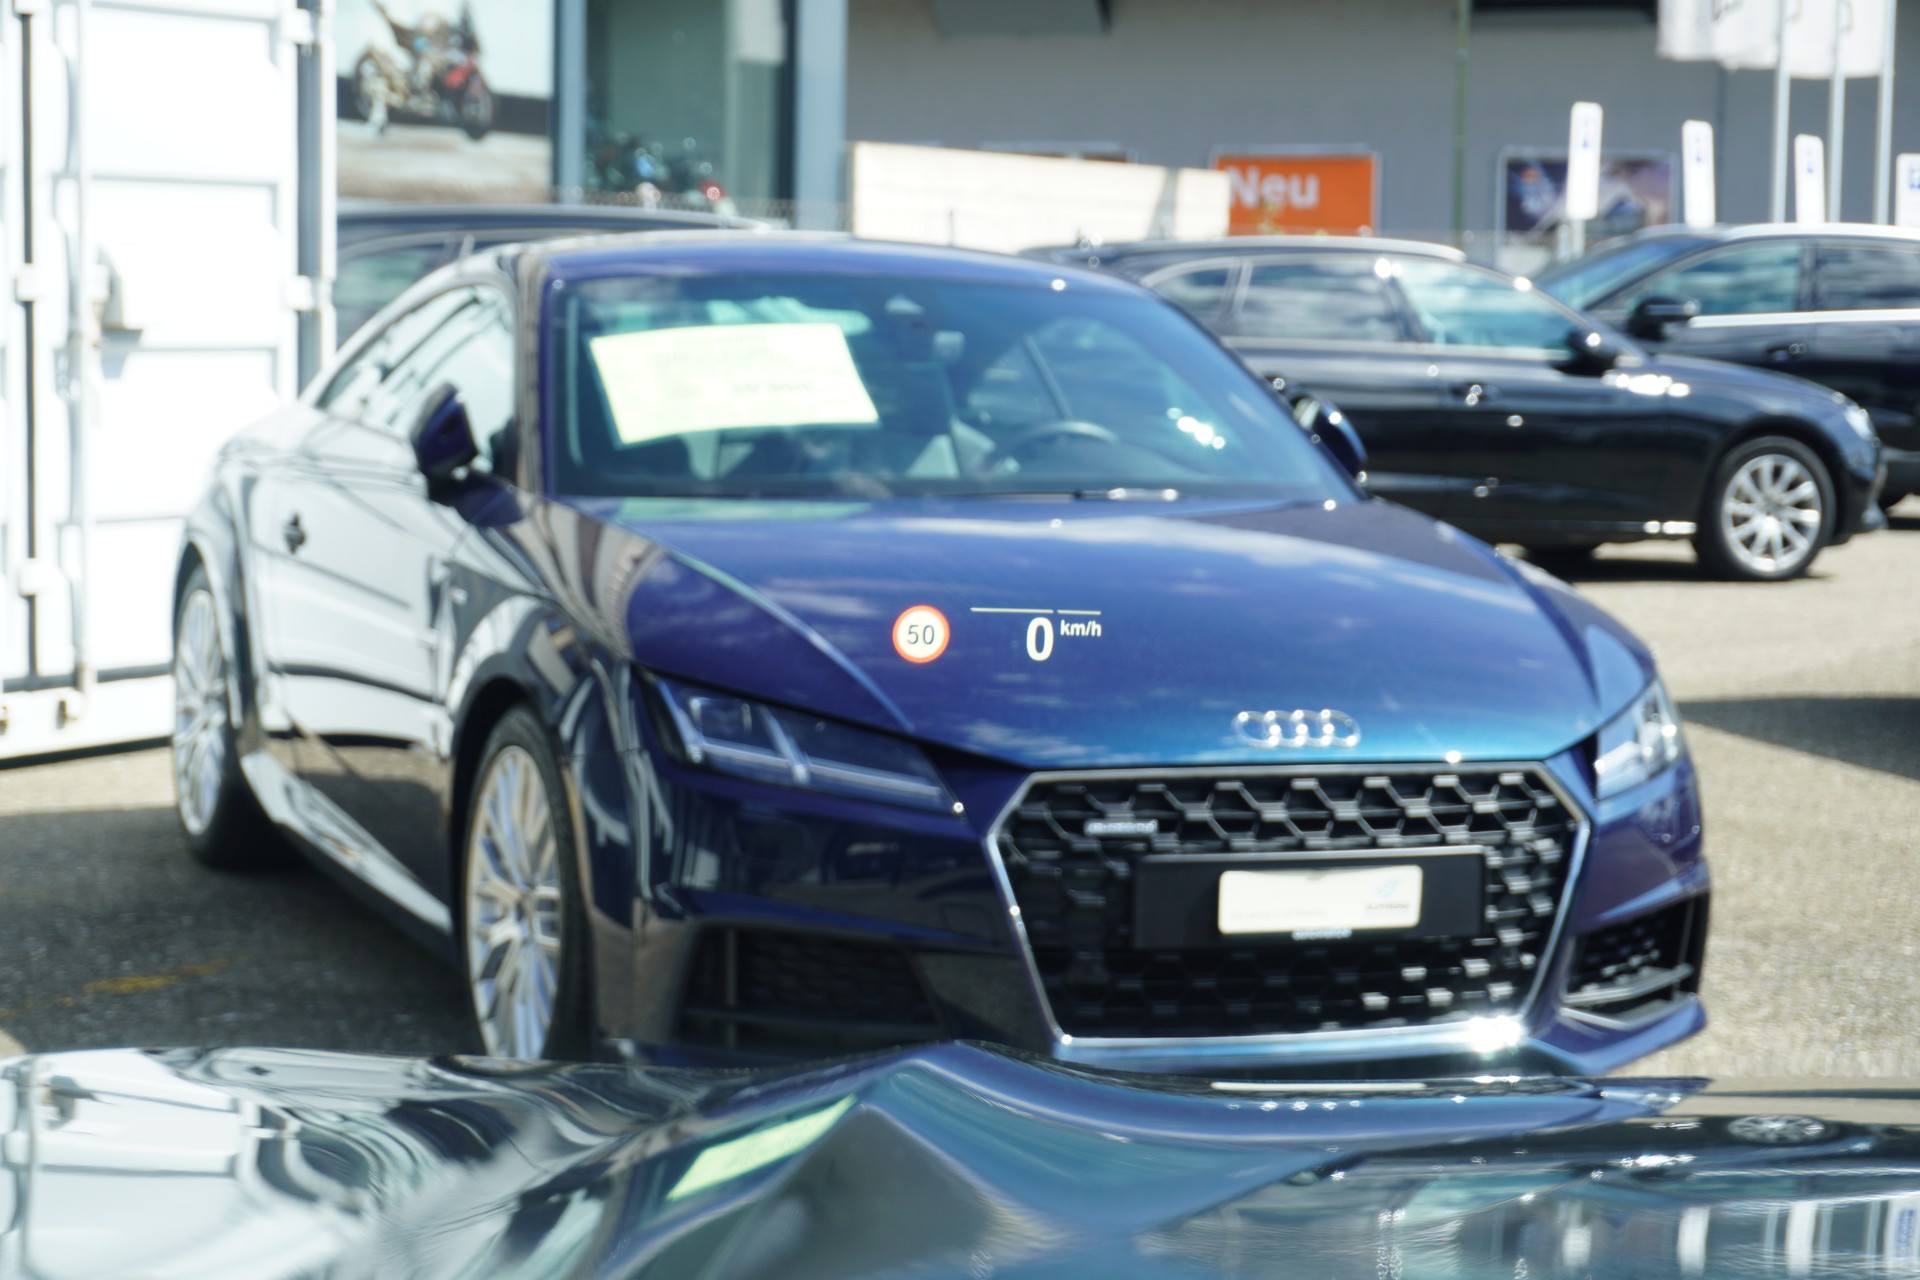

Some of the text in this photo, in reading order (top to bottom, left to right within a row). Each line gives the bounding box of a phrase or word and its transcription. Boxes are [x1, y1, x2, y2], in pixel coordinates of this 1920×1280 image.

[1225, 165, 1320, 209] Neu
[907, 624, 935, 645] 50
[1026, 616, 1102, 661] 0 km/h
